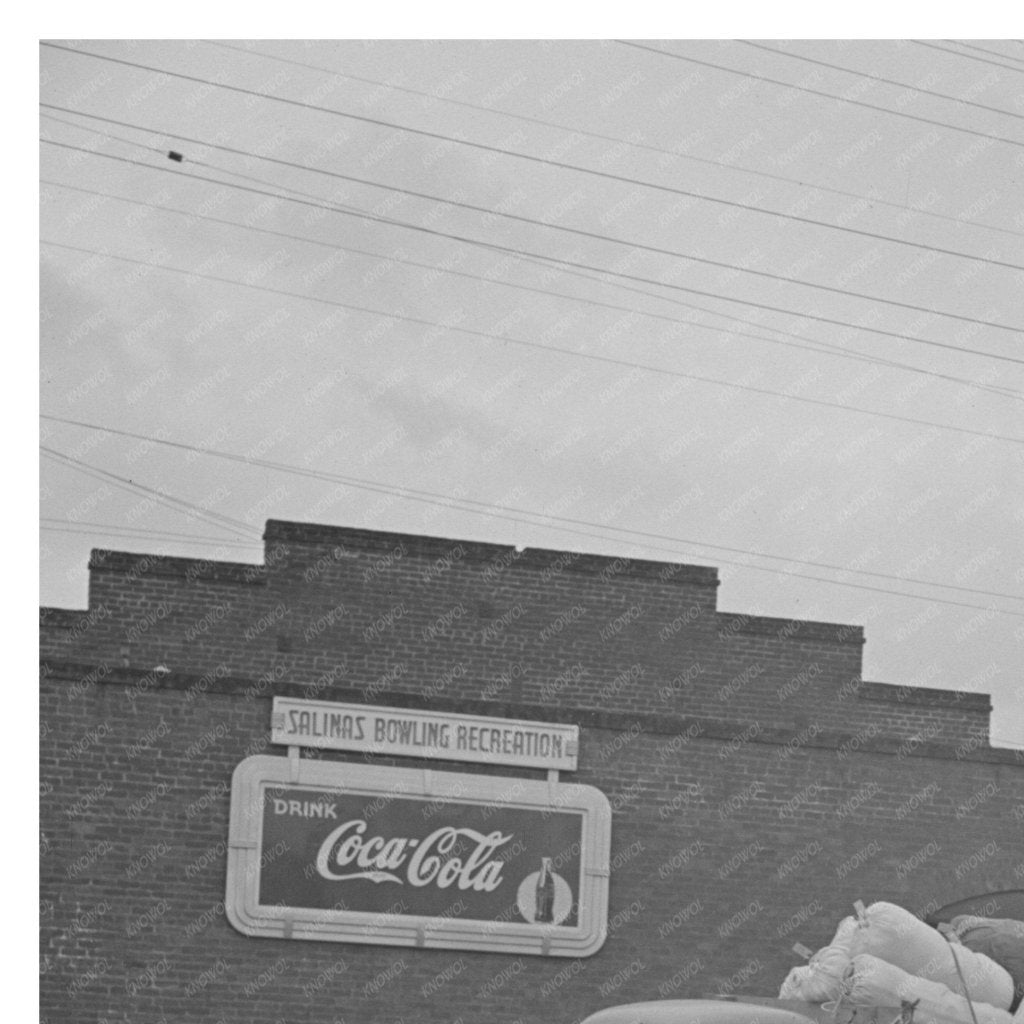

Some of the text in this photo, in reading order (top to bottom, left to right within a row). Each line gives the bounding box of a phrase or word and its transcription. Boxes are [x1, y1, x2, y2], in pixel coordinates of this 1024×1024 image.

[287, 709, 563, 759] SALINAS BOWLING RECREATION
[273, 798, 338, 819] DRINK
[315, 819, 514, 892] Coca-Cola
